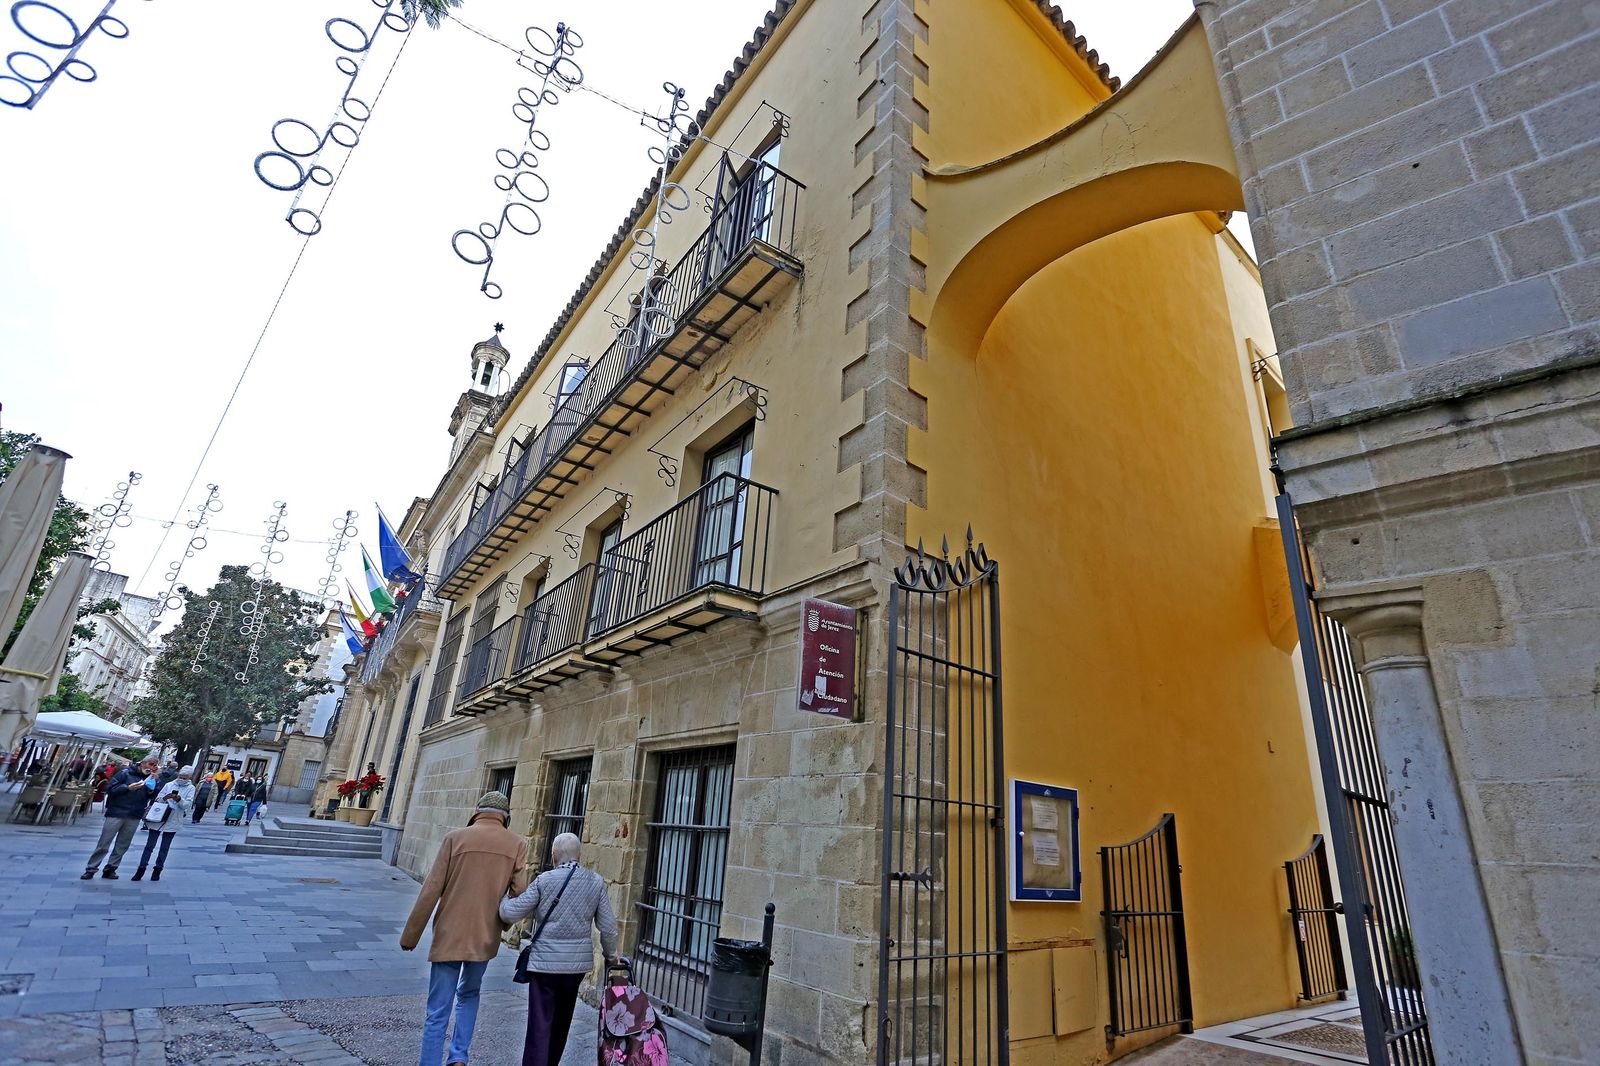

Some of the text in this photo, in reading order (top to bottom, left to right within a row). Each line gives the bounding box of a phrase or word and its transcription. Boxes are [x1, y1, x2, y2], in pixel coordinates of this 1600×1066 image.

[821, 619, 853, 630] Ayuntamiento
[820, 644, 840, 654] Oficina
[818, 668, 844, 678] Atención
[817, 693, 847, 703] Ciudadano
